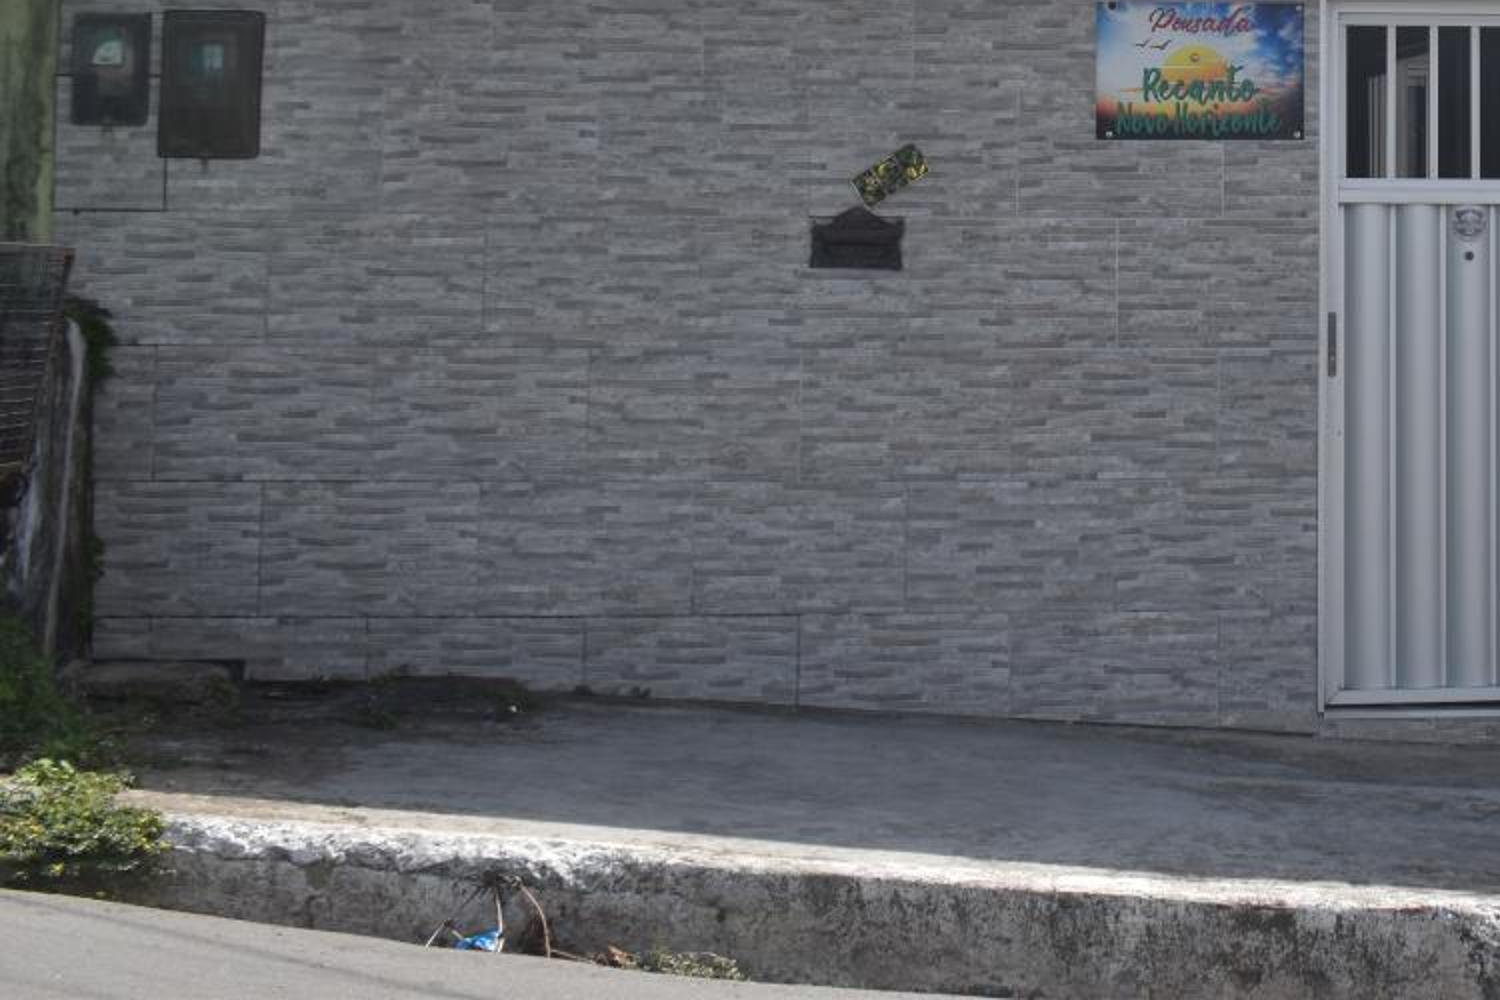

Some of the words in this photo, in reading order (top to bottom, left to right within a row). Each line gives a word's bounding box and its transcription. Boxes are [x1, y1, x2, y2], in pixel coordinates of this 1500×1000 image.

[1150, 7, 1253, 35] Pousada
[1143, 64, 1258, 103] Recanto
[1117, 102, 1170, 133] Novo
[1174, 103, 1281, 135] Horizonte
